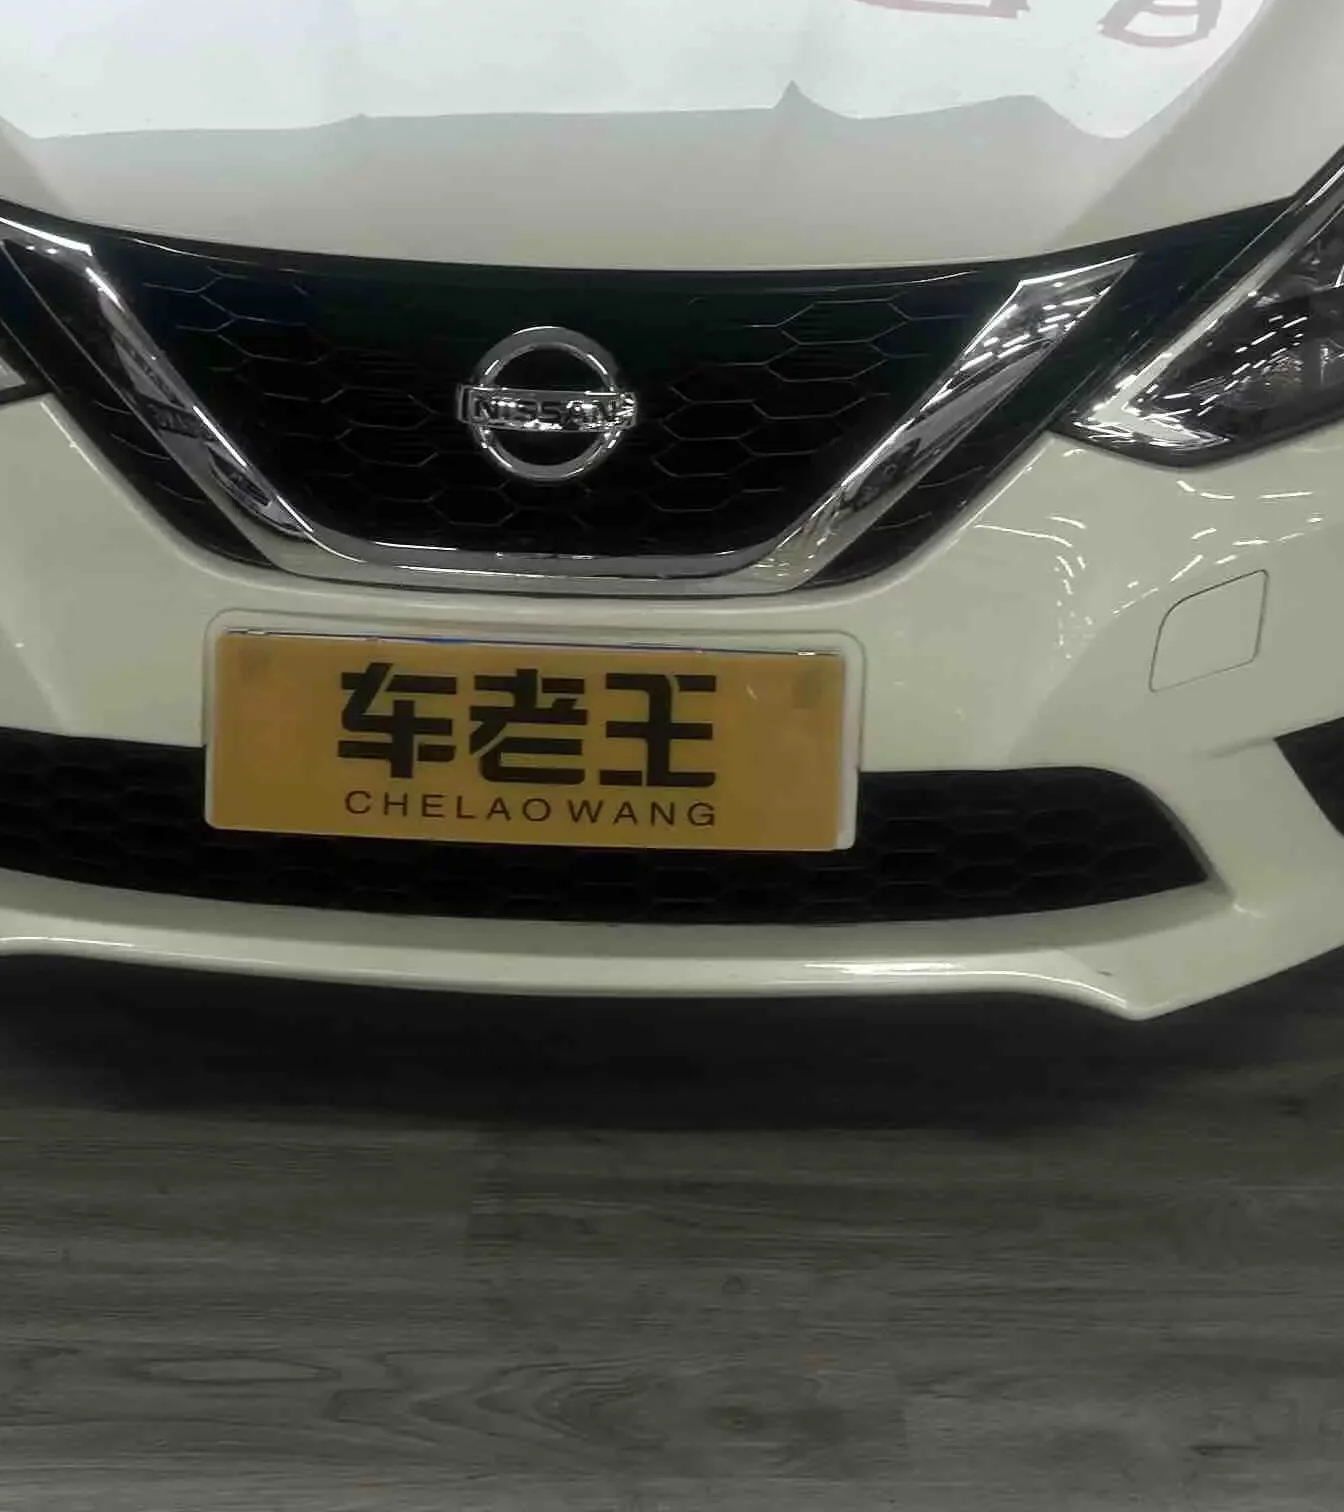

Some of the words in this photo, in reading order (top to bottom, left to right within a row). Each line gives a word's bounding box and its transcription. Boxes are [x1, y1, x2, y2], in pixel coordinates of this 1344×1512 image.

[472, 395, 611, 426] NISSAN
[337, 662, 717, 788] 车老王
[344, 790, 717, 828] CHELAOWANG
